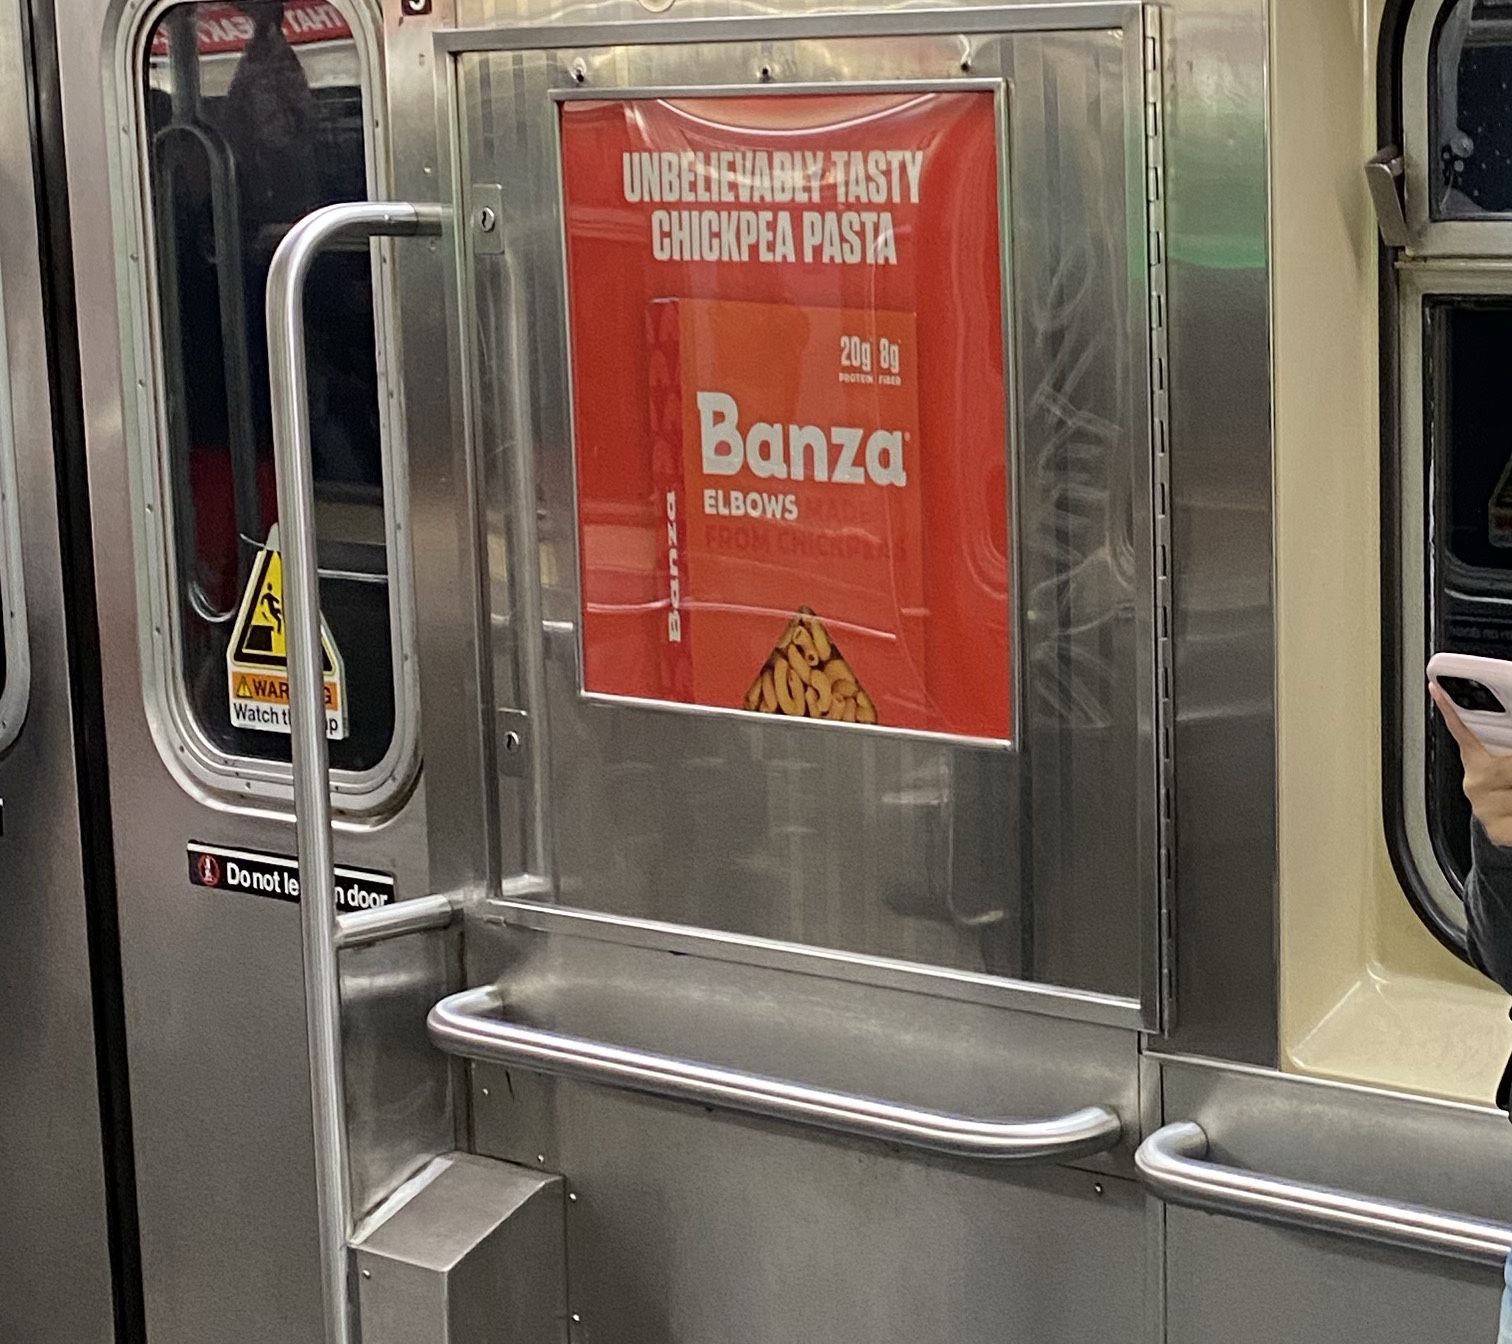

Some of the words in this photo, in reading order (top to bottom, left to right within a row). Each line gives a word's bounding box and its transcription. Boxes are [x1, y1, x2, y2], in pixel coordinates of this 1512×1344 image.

[622, 150, 825, 203] UNBELIEVABLY
[830, 150, 923, 204] TASTY
[651, 210, 796, 263] CHICKPEA
[802, 211, 897, 265] PASTA
[840, 335, 872, 372] 20g
[880, 338, 899, 374] 8g
[697, 391, 906, 487] Banza
[704, 489, 799, 521] ELBOWS
[667, 490, 681, 642] Banza
[233, 702, 279, 725] Watch
[252, 678, 333, 705] WARG
[226, 861, 250, 888] Do
[252, 871, 281, 893] not
[284, 874, 300, 897] le
[347, 884, 388, 909] door
